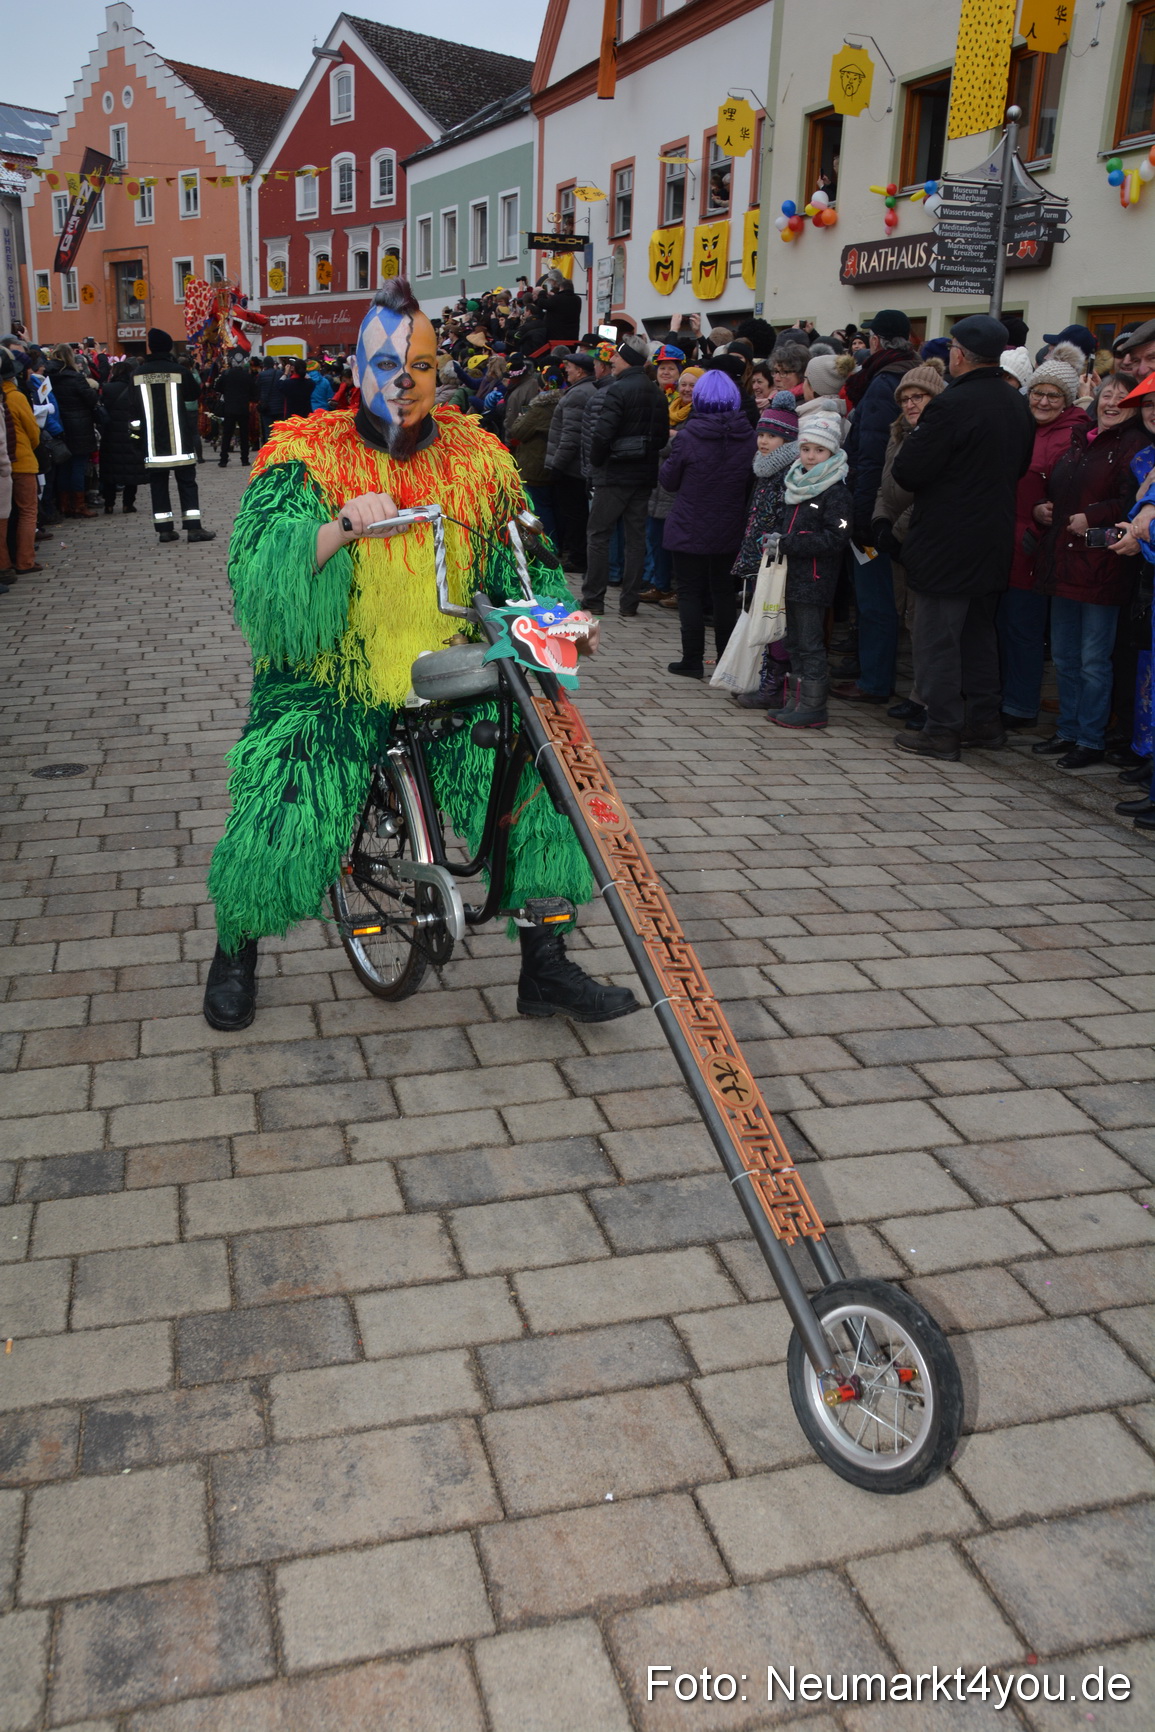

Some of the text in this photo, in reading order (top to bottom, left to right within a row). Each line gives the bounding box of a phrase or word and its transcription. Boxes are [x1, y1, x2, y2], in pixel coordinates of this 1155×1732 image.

[952, 186, 988, 195] Museum im
[952, 193, 986, 202] Hollerhaus
[942, 208, 994, 219] Wassertretanlage
[941, 223, 991, 232] Meditationshaus
[3, 228, 13, 271] UHREN
[947, 242, 988, 251] Mariengrotte
[858, 242, 928, 275] RATHAUS
[953, 249, 984, 258] Kreuzberg
[940, 263, 988, 274] Franziskuspark
[945, 279, 981, 287] Kulturhaus
[939, 285, 985, 295] Stadtbücherei
[8, 276, 17, 321] SCHMU
[117, 327, 147, 338] GÖTZ
